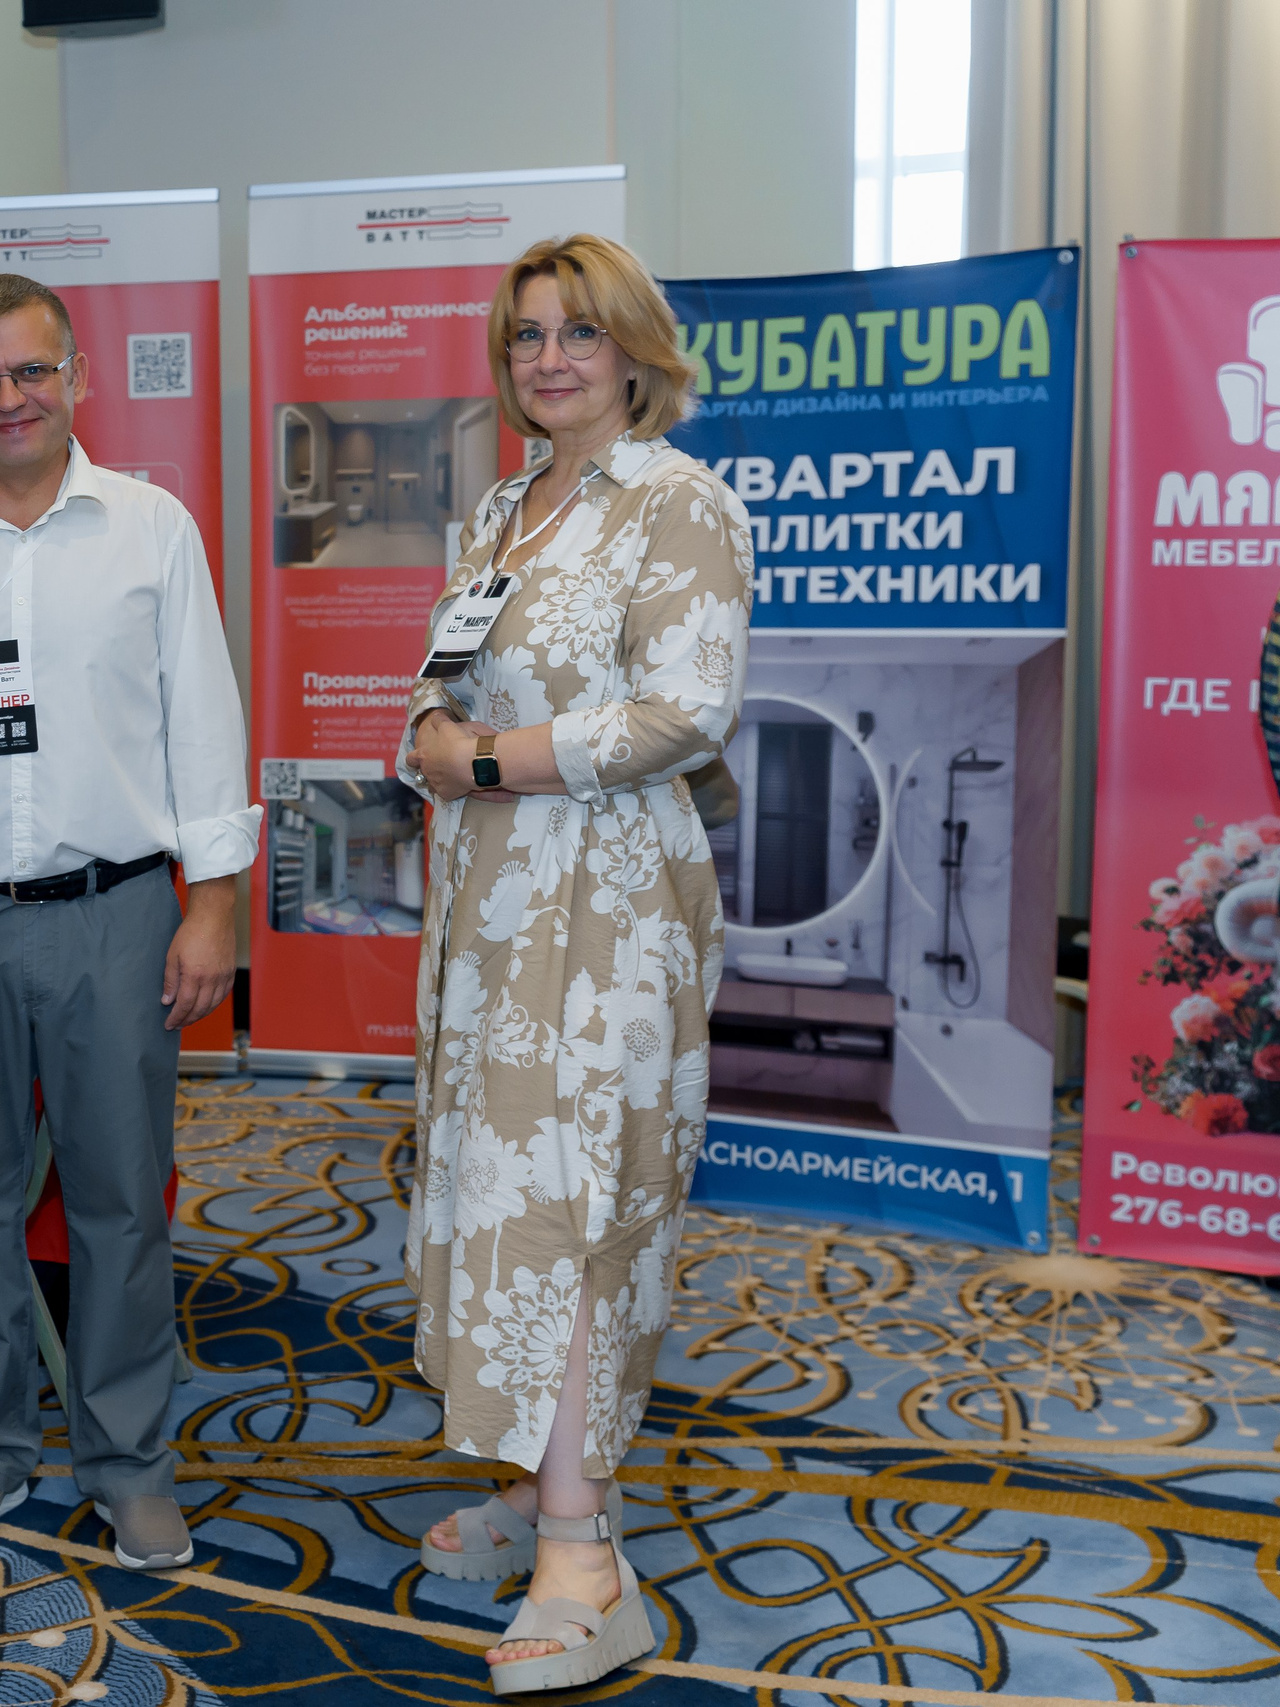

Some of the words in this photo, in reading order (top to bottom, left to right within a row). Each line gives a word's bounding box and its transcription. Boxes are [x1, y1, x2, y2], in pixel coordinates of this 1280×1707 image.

[366, 208, 427, 221] МАСТЕР
[366, 230, 426, 243] ВАТТ
[305, 302, 386, 323] Альбом
[305, 321, 409, 346] решений:
[676, 299, 1052, 396] КУБАТУРА
[772, 391, 883, 418] ДИЗАЙНА
[888, 394, 905, 410] И
[911, 384, 1049, 408] ИНТЕРЬЕРА
[1154, 470, 1280, 528] МЯ
[1143, 677, 1231, 717] ГДЕ
[1007, 1171, 1024, 1203] 1
[1110, 1150, 1280, 1199] Револю
